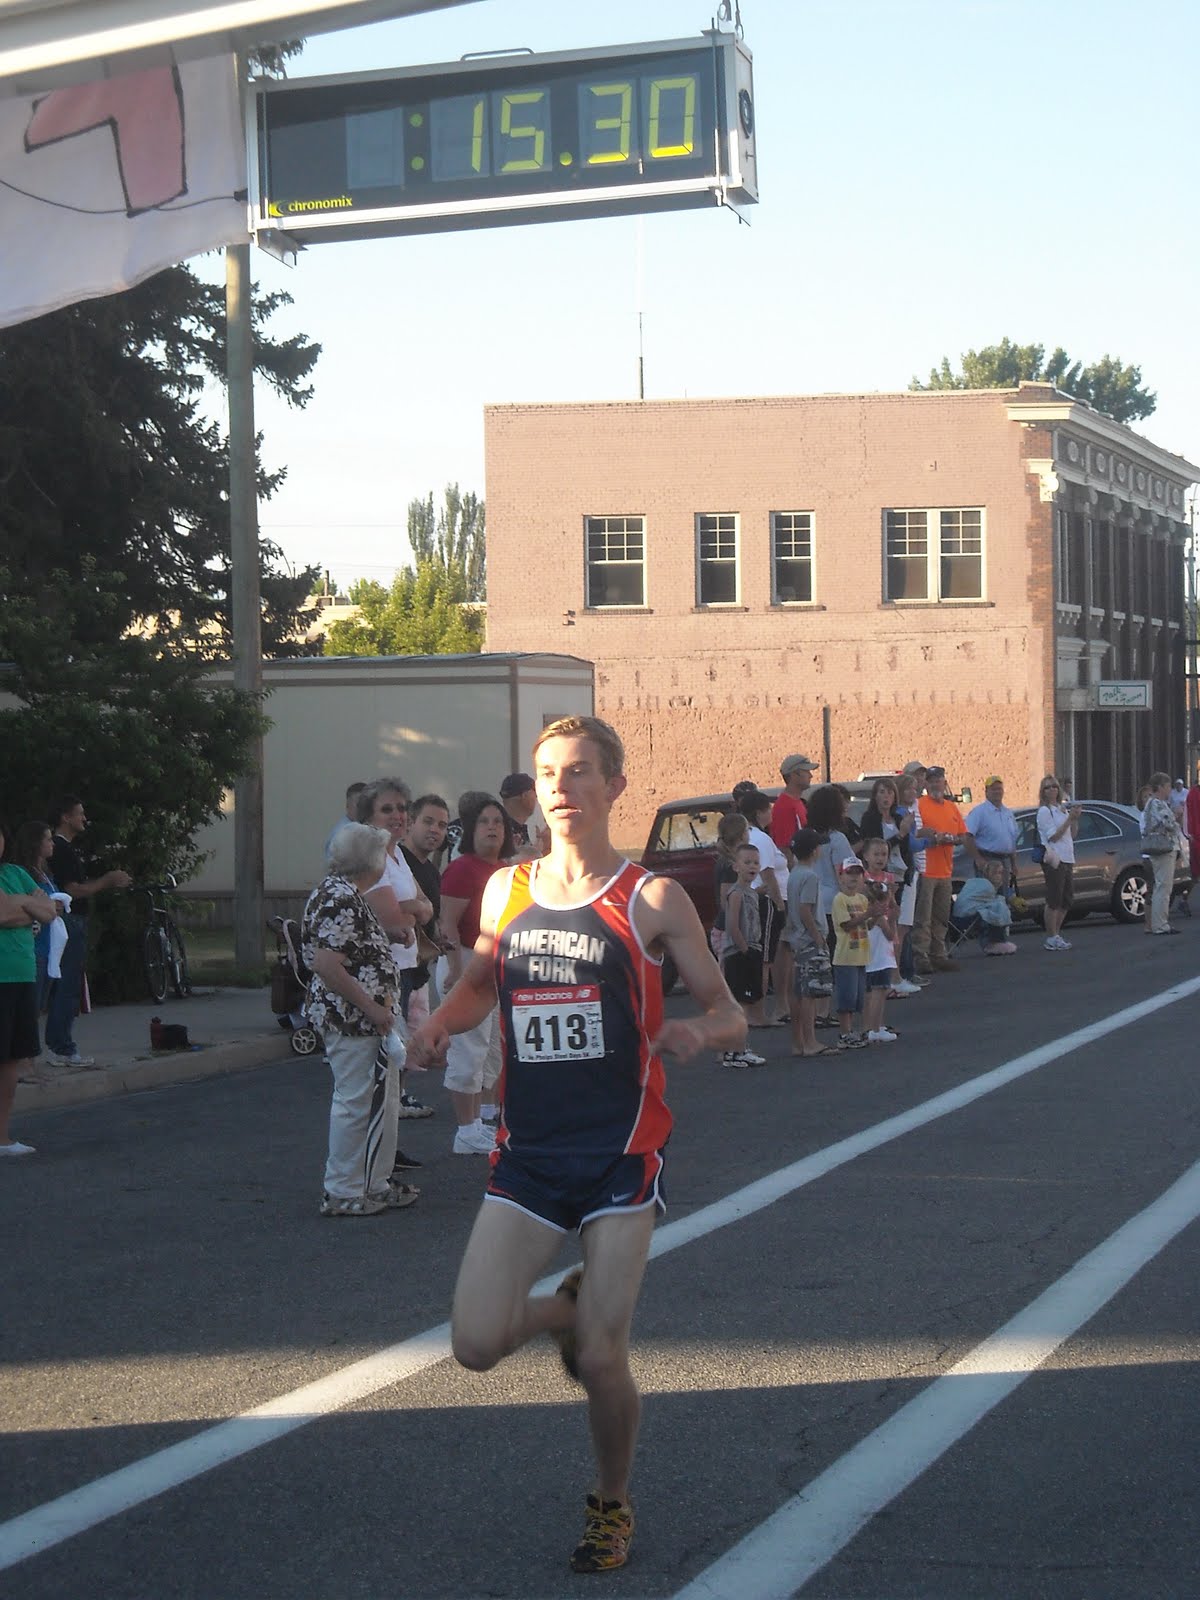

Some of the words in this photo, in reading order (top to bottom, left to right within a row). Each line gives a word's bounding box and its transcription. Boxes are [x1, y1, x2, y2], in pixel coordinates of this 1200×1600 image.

[288, 195, 353, 211] chronomix
[508, 929, 606, 965] AMERICAN
[528, 956, 577, 985] FORK
[535, 992, 573, 1000] balance
[525, 1014, 588, 1052] 413
